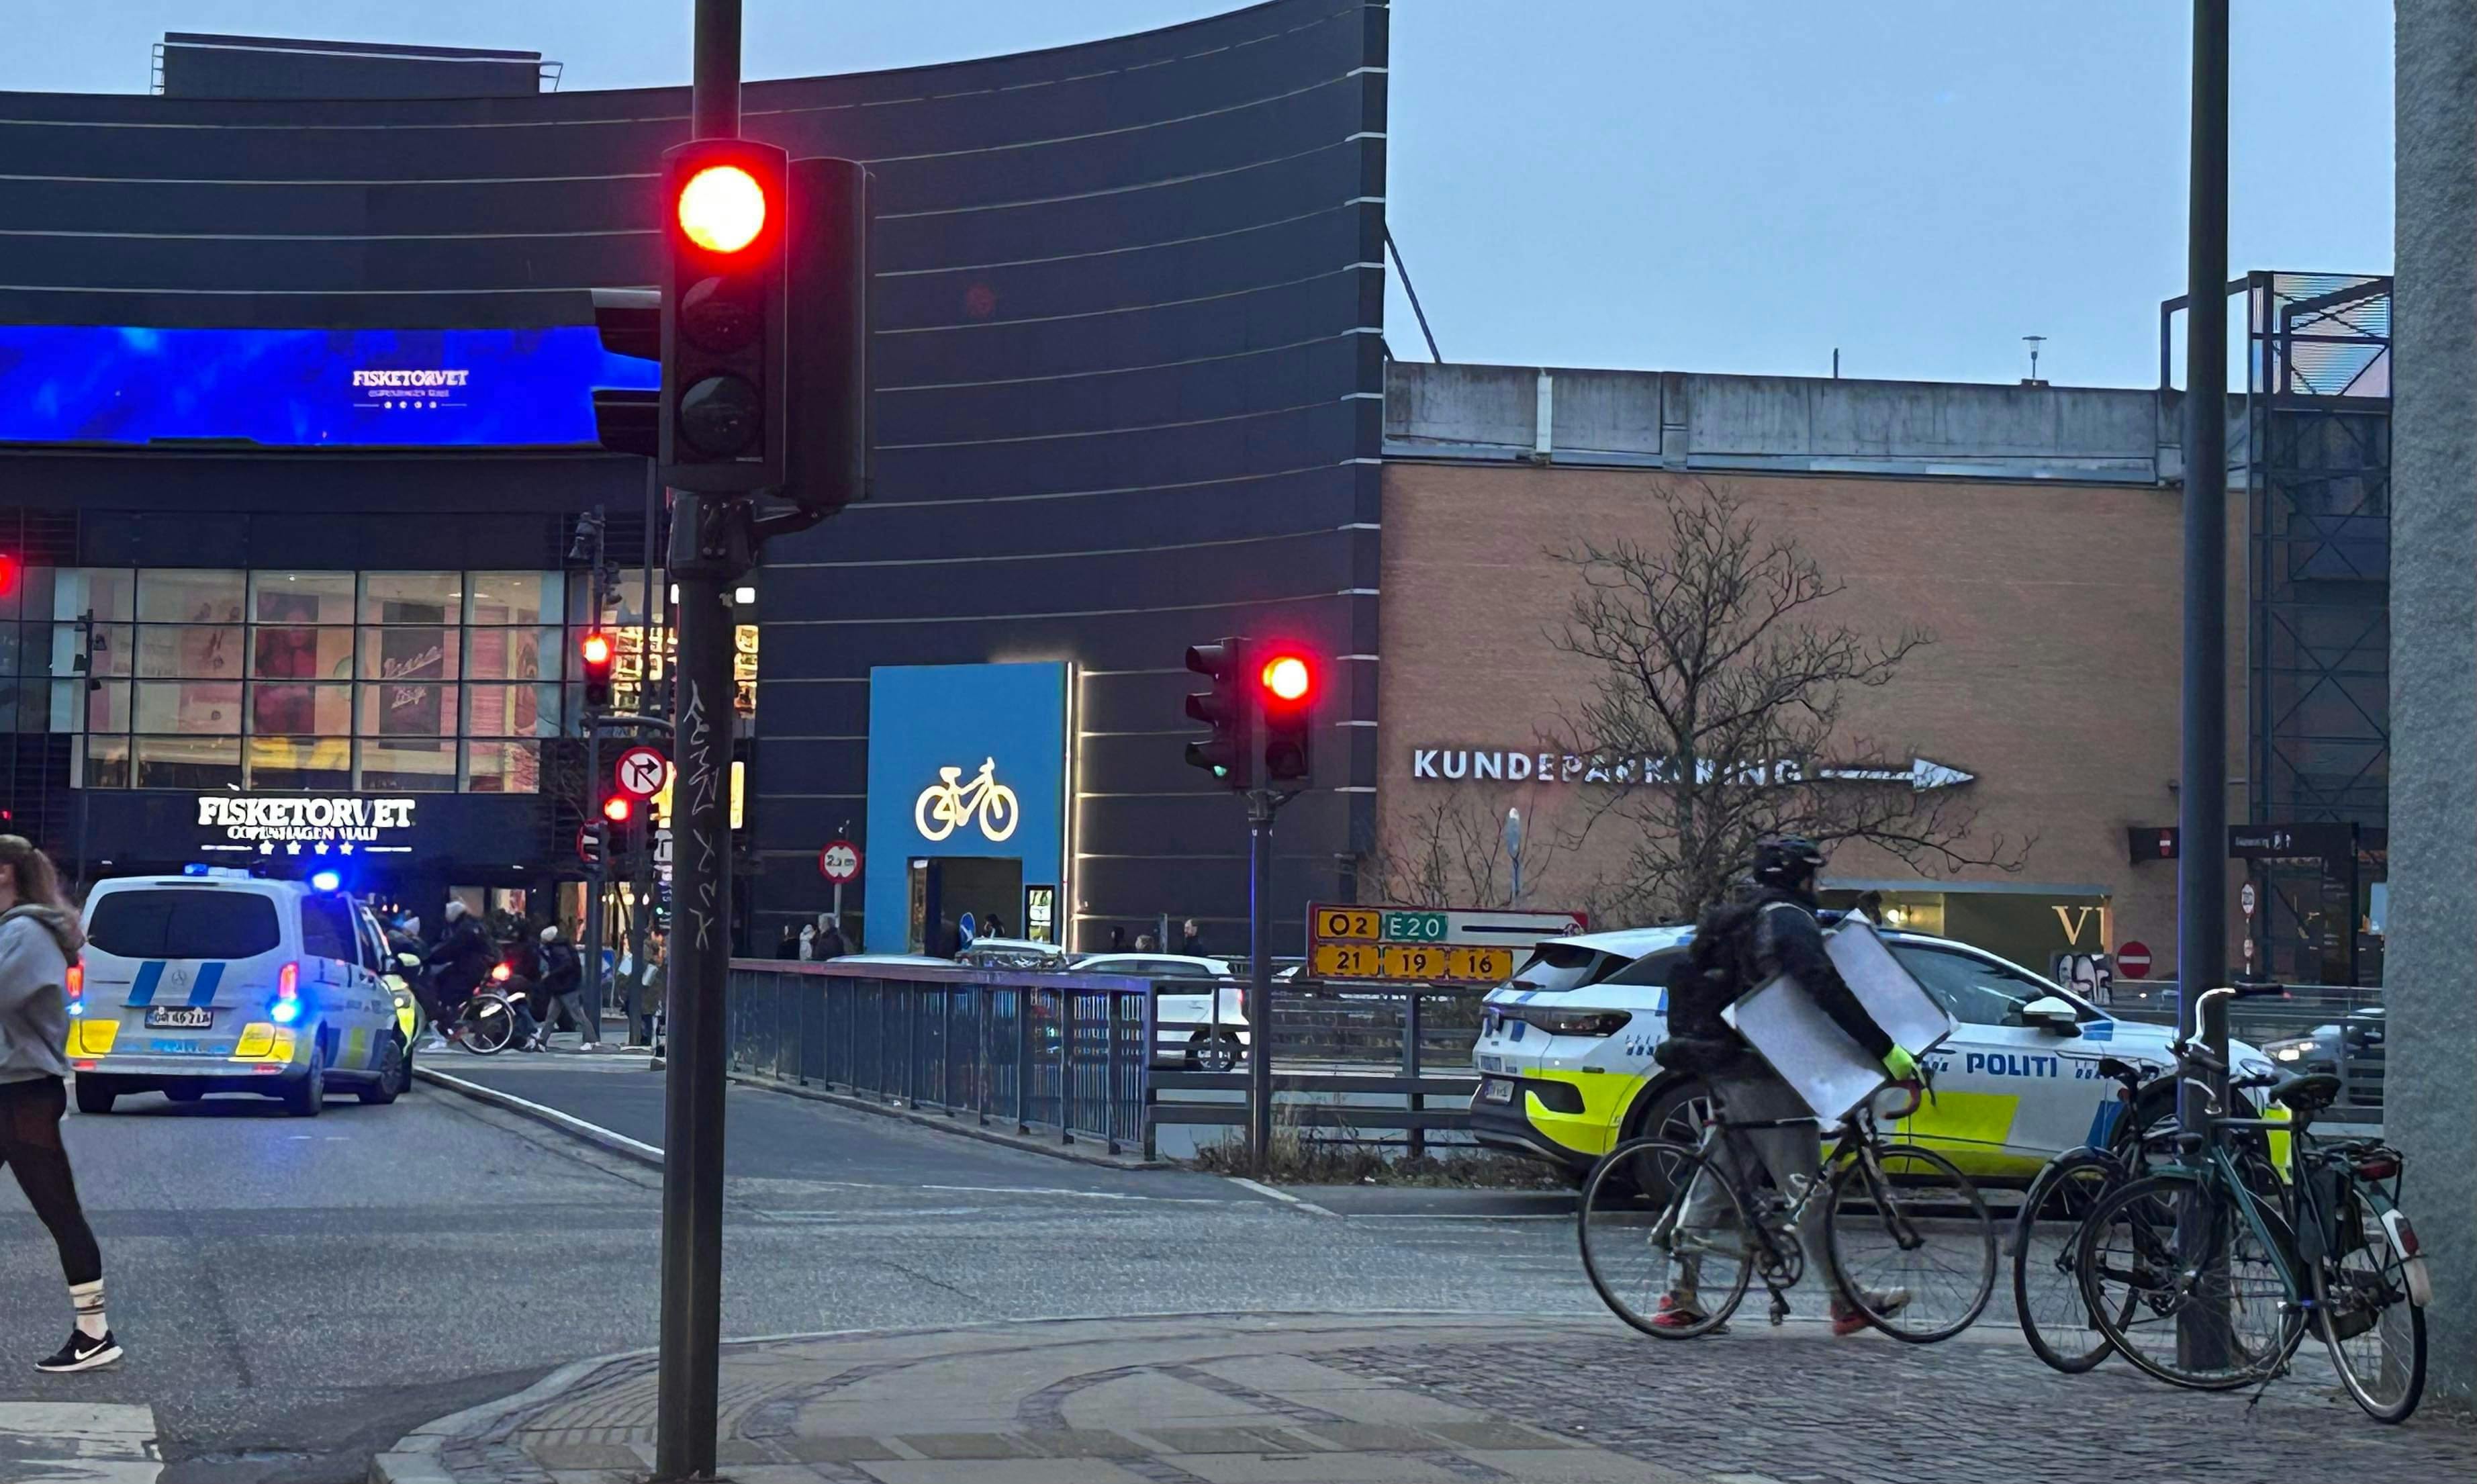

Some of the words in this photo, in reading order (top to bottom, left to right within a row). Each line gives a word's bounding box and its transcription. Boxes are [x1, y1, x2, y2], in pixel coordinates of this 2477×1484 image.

[353, 370, 469, 386] FISKETORVET
[198, 797, 415, 827] FISKETORVET
[1390, 917, 1440, 937] E20
[1337, 951, 1360, 970] 21
[1403, 954, 1427, 972] 19
[1468, 954, 1493, 973] 16
[1966, 1052, 2057, 1077] POLITI
